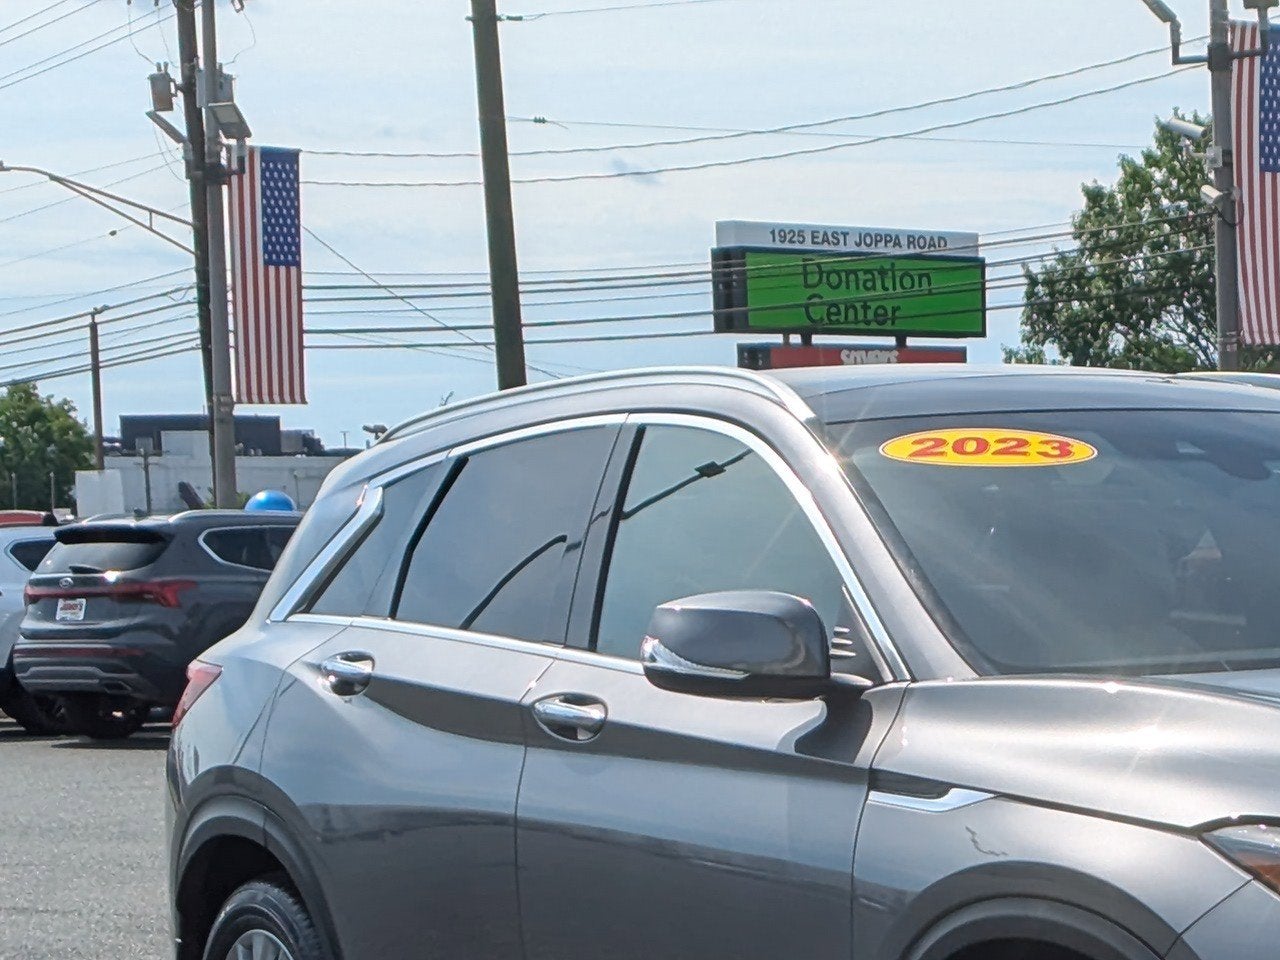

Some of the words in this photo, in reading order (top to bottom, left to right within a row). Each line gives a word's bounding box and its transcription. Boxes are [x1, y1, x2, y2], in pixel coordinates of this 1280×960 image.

[769, 229, 805, 245] 1925
[810, 230, 850, 246] EAST
[854, 232, 902, 248] JOPPA
[906, 235, 948, 250] ROAD
[802, 257, 932, 292] Donation
[804, 292, 902, 326] Center
[906, 436, 1075, 459] 2023
